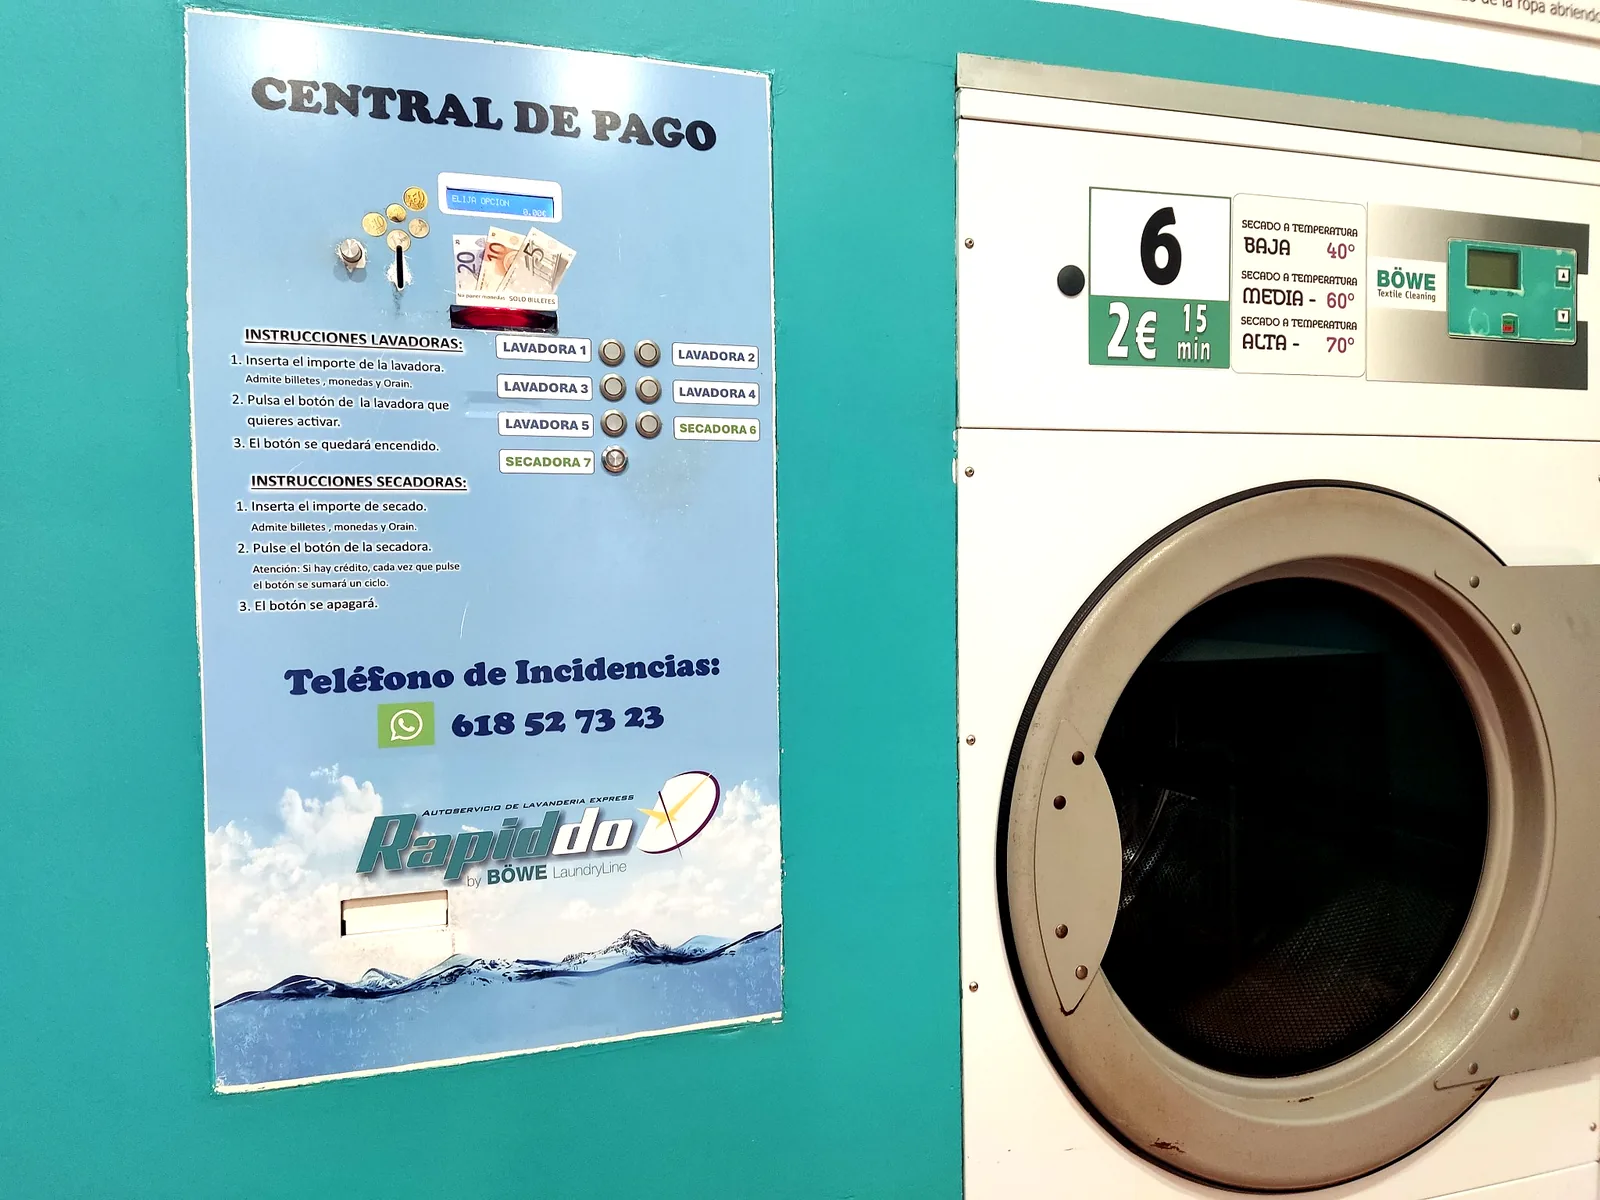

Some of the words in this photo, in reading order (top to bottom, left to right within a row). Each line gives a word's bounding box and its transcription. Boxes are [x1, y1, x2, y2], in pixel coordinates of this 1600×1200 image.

[1518, 0, 1545, 15] ropa
[251, 77, 503, 130] CENTRAL
[514, 100, 581, 138] DE
[592, 109, 716, 151] PAGO
[452, 195, 477, 204] ELIJA
[481, 198, 510, 207] OPCION
[1242, 219, 1281, 231] SECADO
[1284, 223, 1290, 232] A
[1292, 224, 1358, 238] TEMPERATURA
[487, 242, 506, 262] 10
[523, 242, 544, 263] 5
[1140, 207, 1182, 286] 6
[1244, 237, 1291, 256] BAJA
[456, 252, 476, 274] 20
[1241, 270, 1280, 281] SECADO
[1283, 273, 1289, 281] A
[1291, 273, 1358, 286] TEMPERATURA
[1377, 267, 1436, 291] BÖWE
[1243, 288, 1303, 306] MEDIA
[1378, 289, 1402, 299] Textile
[1405, 291, 1436, 302] Cleaning
[1183, 303, 1207, 333] 15
[1241, 317, 1280, 327] SECADO
[1283, 318, 1289, 327] A
[1291, 319, 1357, 330] TEMPERATURA
[245, 328, 367, 345] INSTRUCCIONES
[371, 334, 463, 350] LAVADORAS:
[1107, 302, 1158, 360] 2€
[503, 342, 576, 354] LAVADORA
[580, 346, 587, 355] 1
[1177, 337, 1211, 360] min
[1242, 334, 1286, 350] ALTA
[231, 355, 242, 365] 1.
[246, 355, 289, 367] Inserta
[293, 356, 304, 367] el
[307, 357, 356, 369] importe
[359, 359, 375, 369] de
[378, 360, 388, 370] la
[391, 360, 444, 372] lavadora.
[678, 350, 745, 361] LAVADORA
[748, 353, 755, 362] 2
[246, 375, 282, 384] Admite
[285, 376, 320, 385] billetes
[328, 378, 373, 387] monedas
[376, 381, 381, 389] y
[384, 380, 412, 388] Orain.
[504, 381, 577, 393] LAVADORA
[581, 384, 588, 394] 3
[679, 388, 746, 398] LAVADORA
[748, 390, 756, 399] 4
[232, 395, 244, 405] 2.
[247, 395, 280, 406] Pulsa
[284, 396, 295, 406] el
[298, 396, 335, 407] botón
[338, 397, 353, 407] de
[360, 398, 370, 408] la
[374, 398, 424, 409] lavadora
[427, 402, 450, 412] que
[247, 416, 293, 427] quieres
[297, 417, 340, 427] activar.
[505, 419, 578, 430] LAVADORA
[582, 421, 589, 430] 5
[679, 423, 746, 434] SECADORA
[749, 426, 756, 434] 6
[234, 438, 245, 448] 3.
[249, 438, 260, 448] El
[264, 438, 300, 449] botón
[304, 441, 318, 449] se
[321, 440, 371, 452] quedará
[374, 440, 439, 451] encendido.
[506, 456, 580, 467] SECADORA
[583, 458, 591, 467] 7
[251, 475, 372, 490] INSTRUCCIONES
[376, 476, 467, 490] SECADORAS:
[236, 502, 247, 512] 1.
[251, 502, 295, 512] Inserta
[298, 502, 309, 512] el
[313, 502, 361, 513] importe
[364, 502, 379, 512] de
[382, 502, 426, 512] secado.
[251, 523, 287, 531] Admite
[290, 523, 326, 531] billetes
[334, 523, 378, 531] monedas
[381, 525, 386, 533] y
[389, 523, 417, 531] Orain.
[238, 544, 249, 554] 2.
[253, 543, 286, 553] Pulse
[290, 543, 301, 553] el
[305, 542, 340, 553] botón
[344, 542, 359, 552] de
[362, 542, 372, 552] la
[376, 542, 431, 552] secadora.
[253, 565, 300, 573] Atención:
[314, 564, 331, 574] hay
[334, 564, 371, 573] crédito,
[373, 563, 395, 571] cada
[415, 564, 433, 573] que
[436, 563, 460, 572] pulse
[253, 581, 262, 589] el
[265, 580, 295, 589] botón
[311, 580, 347, 588] sumará
[364, 579, 389, 587] ciclo.
[240, 602, 250, 612] 3.
[255, 601, 266, 610] El
[269, 600, 306, 610] botón
[310, 602, 323, 610] se
[327, 599, 377, 611] apagará.
[284, 666, 454, 696] Teléfono
[463, 663, 506, 686] de
[515, 654, 720, 684] Incidencias:
[451, 712, 515, 738] 618
[525, 711, 566, 736] 52
[575, 708, 616, 733] 73
[624, 706, 664, 730] 23
[422, 805, 501, 817] AUTOSERVICIO
[523, 798, 586, 809] LAVANDERIA
[589, 794, 634, 804] EXPRESS
[356, 807, 634, 880] Rapiddo
[467, 875, 482, 888] by
[487, 864, 548, 885] BÖWE
[553, 861, 627, 880] LaundryLine
